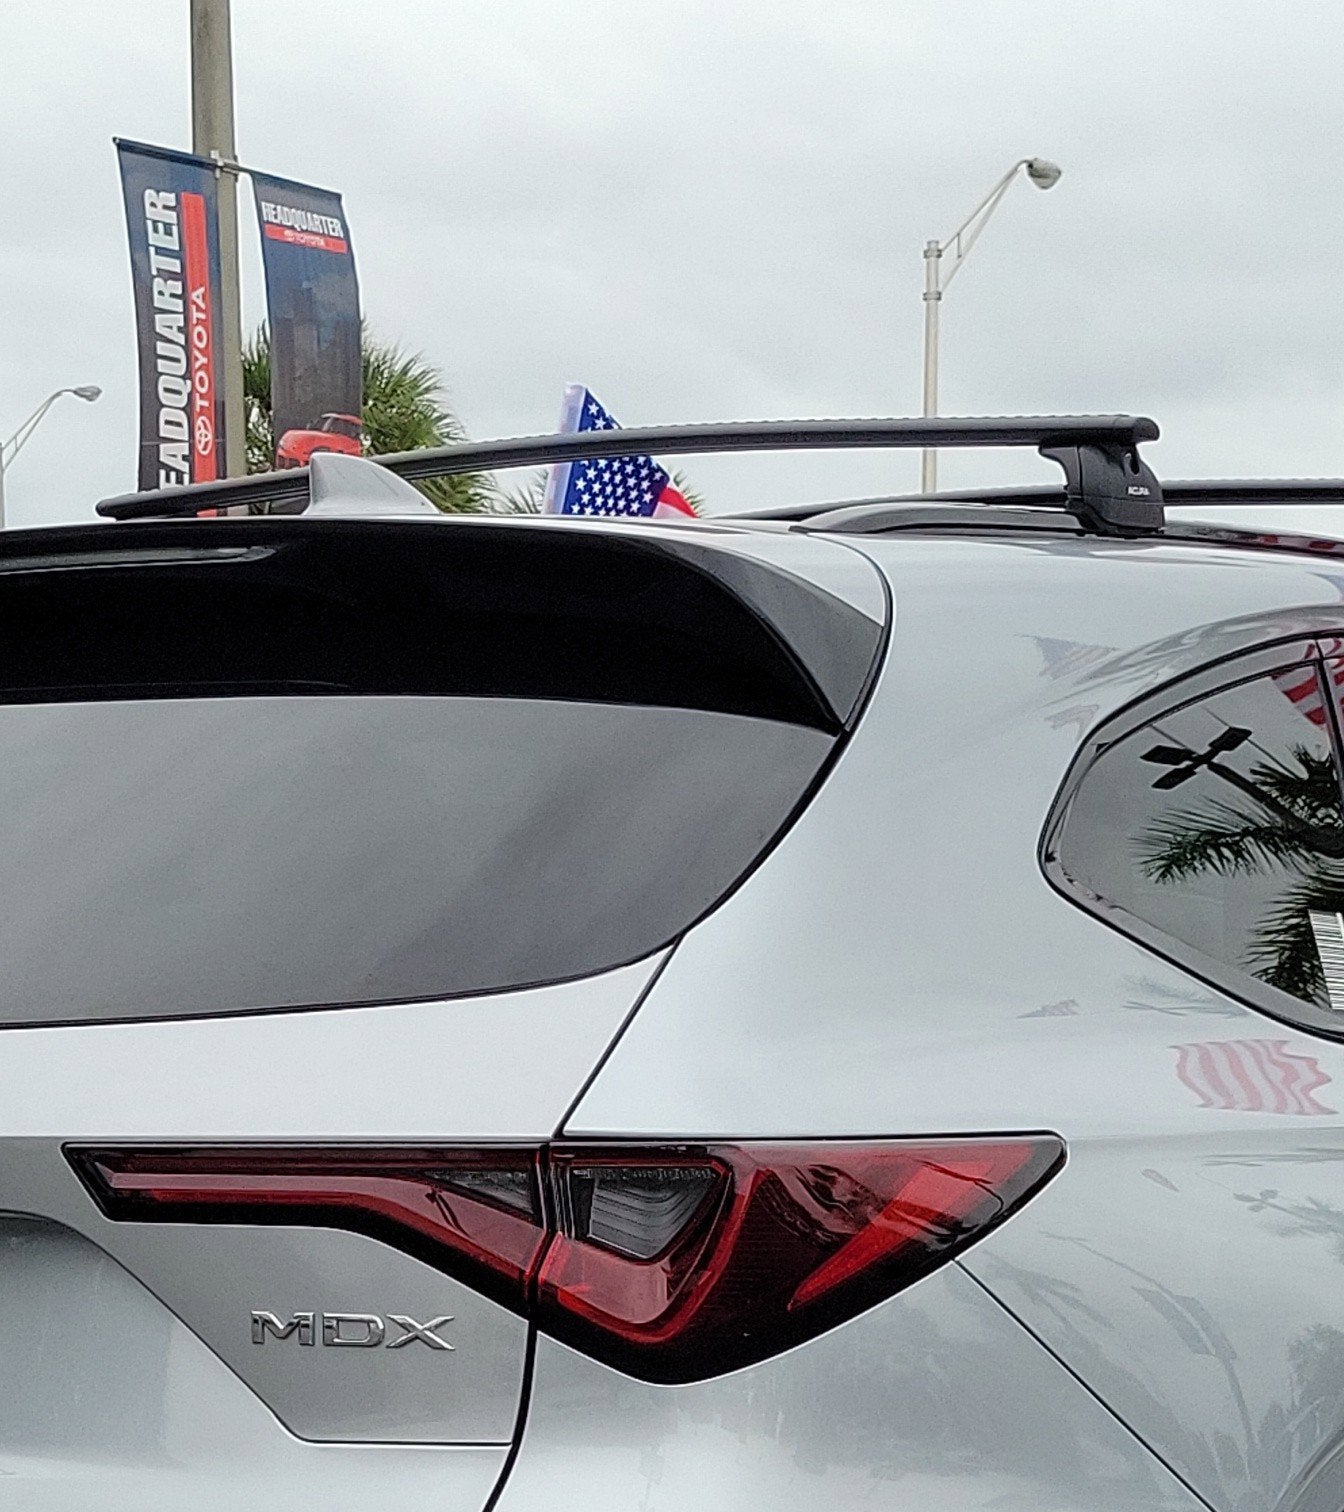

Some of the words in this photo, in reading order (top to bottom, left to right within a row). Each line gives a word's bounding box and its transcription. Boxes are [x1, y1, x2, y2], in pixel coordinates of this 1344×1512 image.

[260, 201, 344, 238] HEADQUARTER
[144, 188, 192, 491] EADQUARTER
[189, 286, 211, 410] TOYOTA
[250, 1310, 456, 1351] MDX
